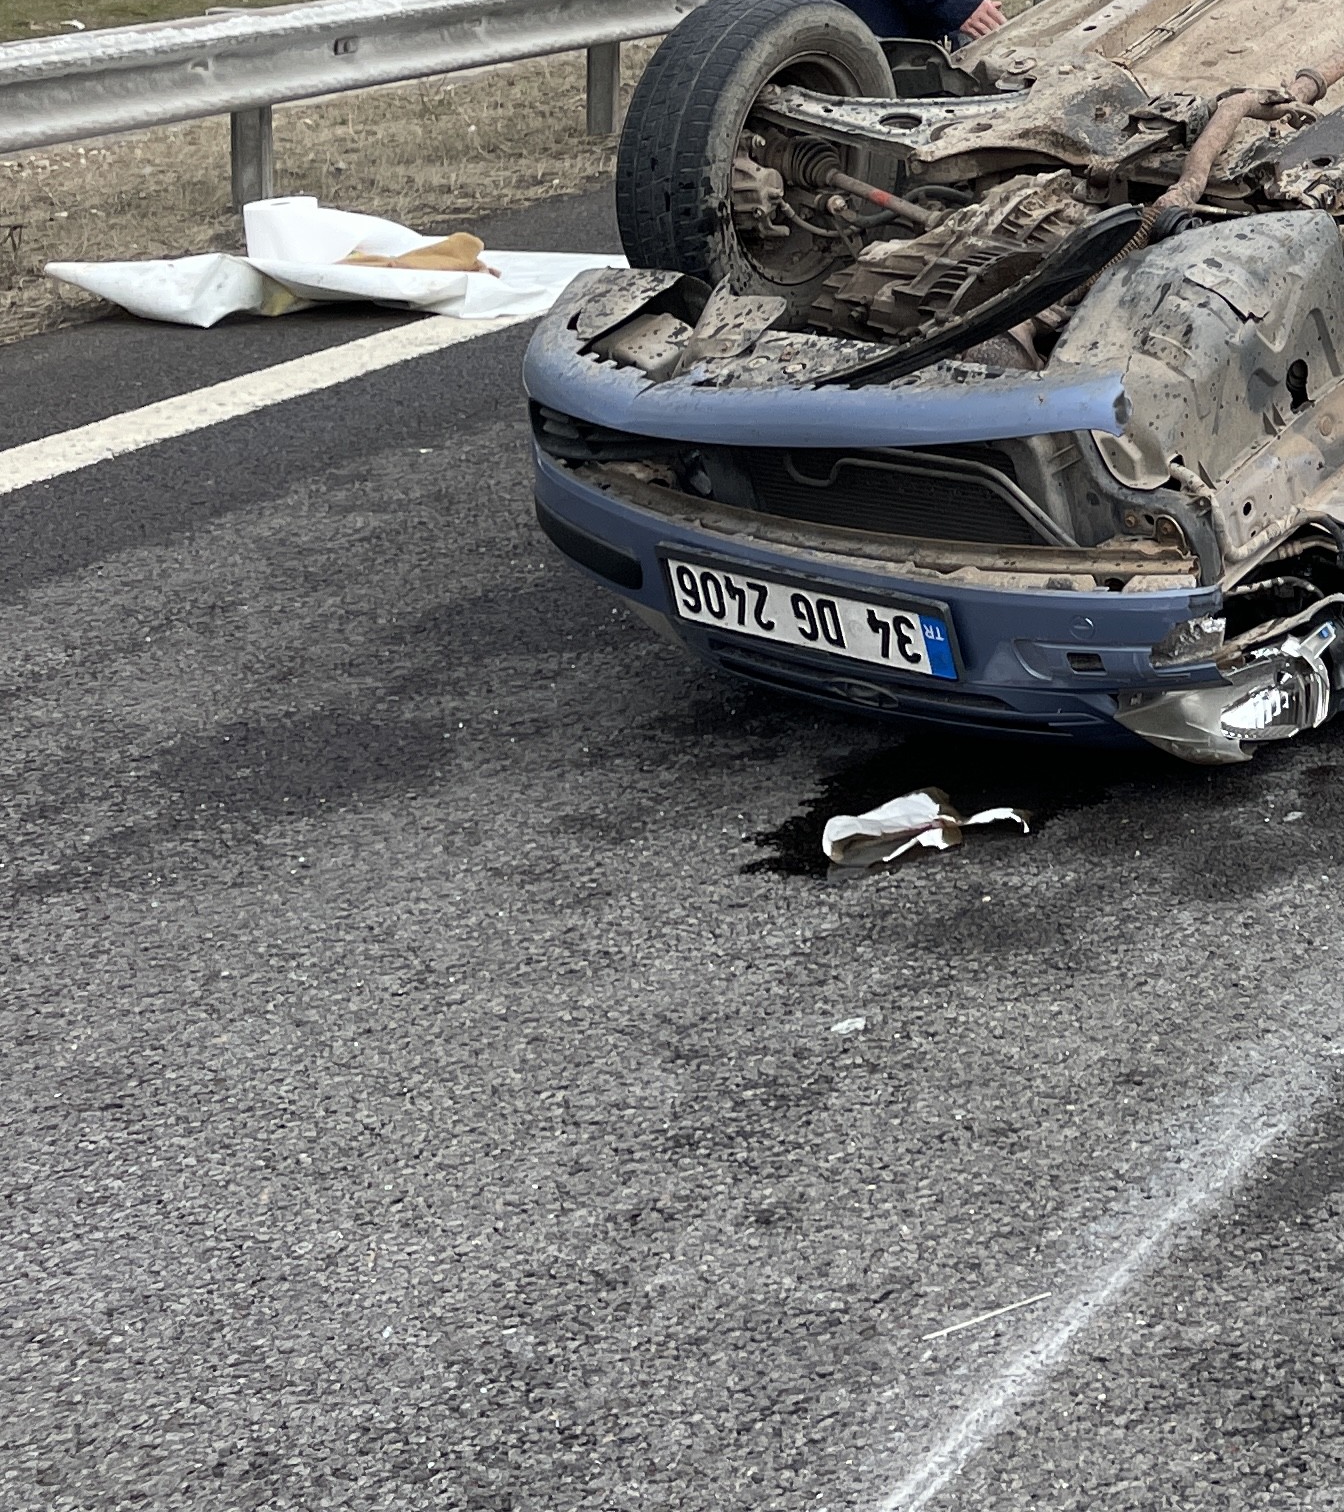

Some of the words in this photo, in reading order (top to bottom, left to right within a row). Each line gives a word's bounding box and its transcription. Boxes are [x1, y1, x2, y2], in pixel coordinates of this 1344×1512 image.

[676, 565, 776, 632] 2406
[790, 593, 847, 650] DG
[866, 608, 922, 665] 34
[923, 623, 946, 642] TR
